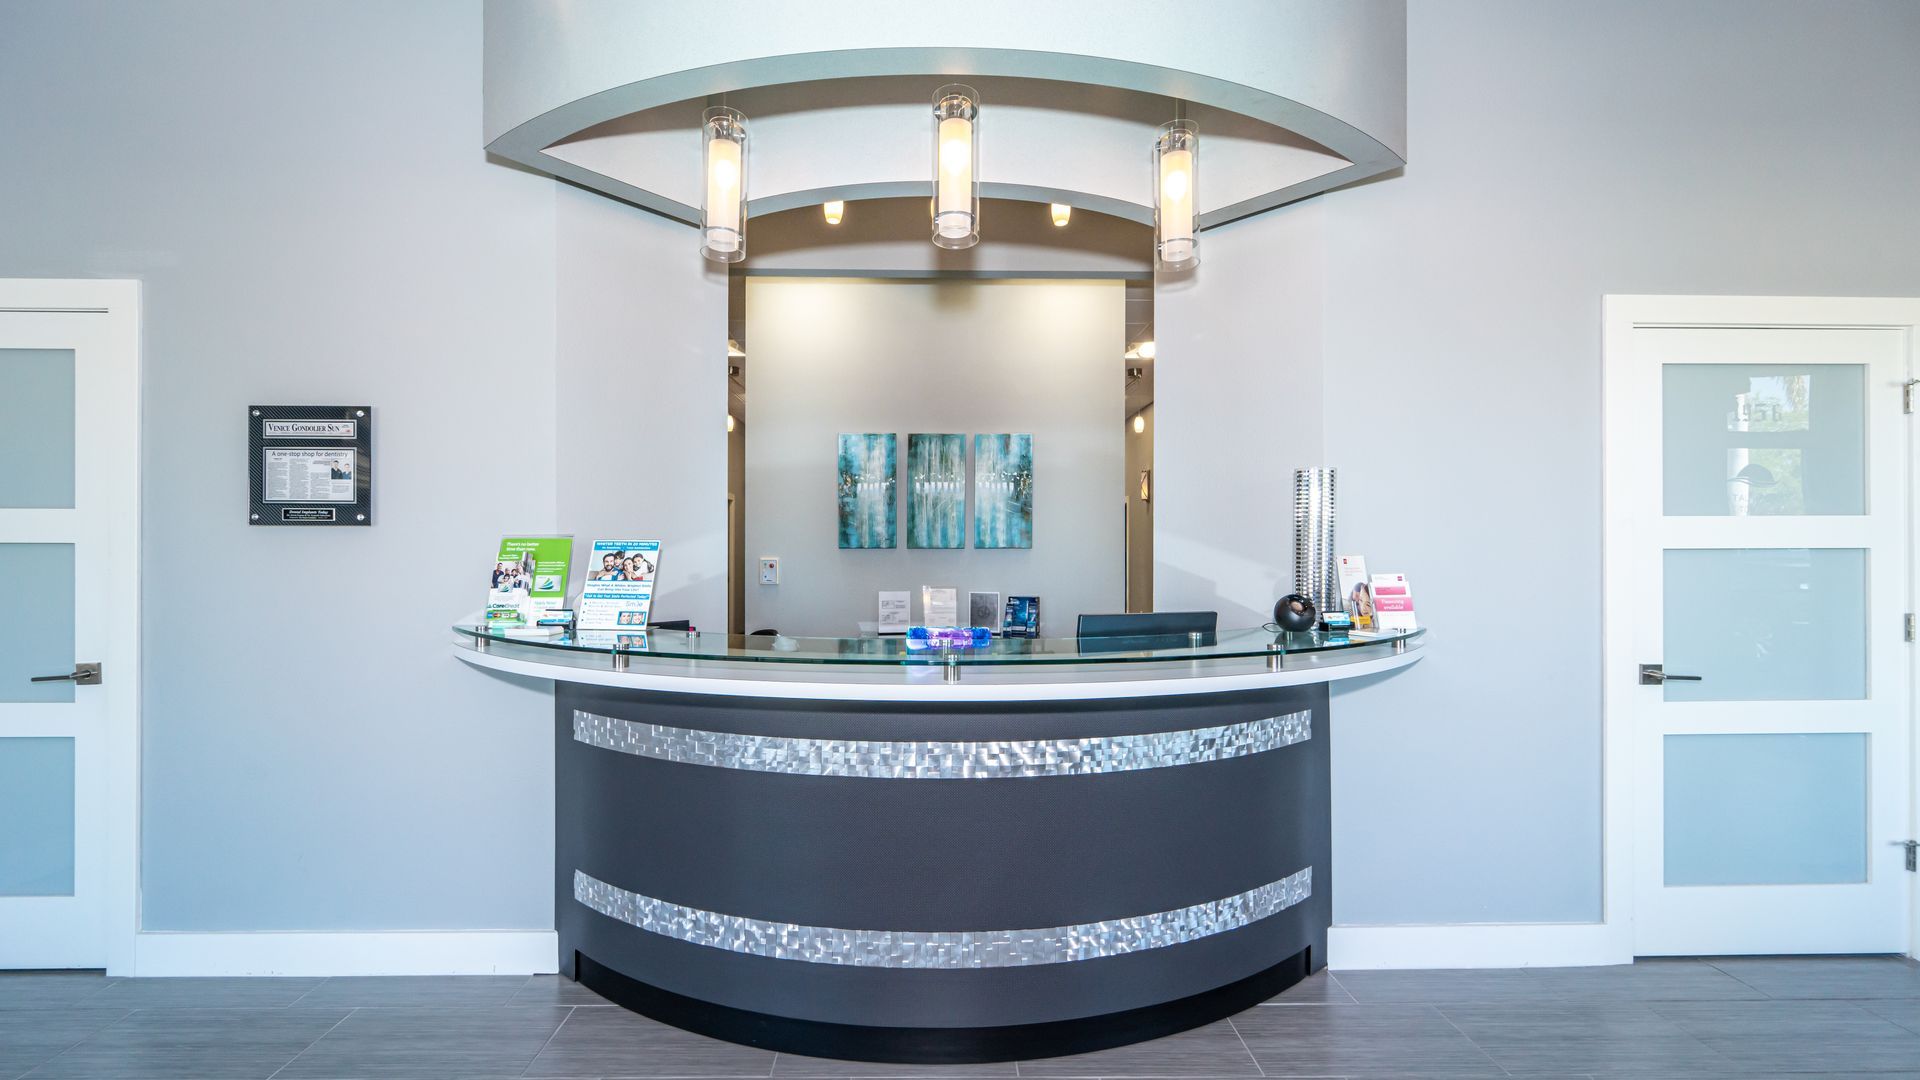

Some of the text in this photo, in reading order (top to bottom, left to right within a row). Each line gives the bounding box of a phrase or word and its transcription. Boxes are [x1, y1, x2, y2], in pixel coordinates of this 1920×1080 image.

[268, 423, 291, 432] VENICE
[291, 423, 327, 432] GONDOLIER
[327, 423, 340, 432] SUN
